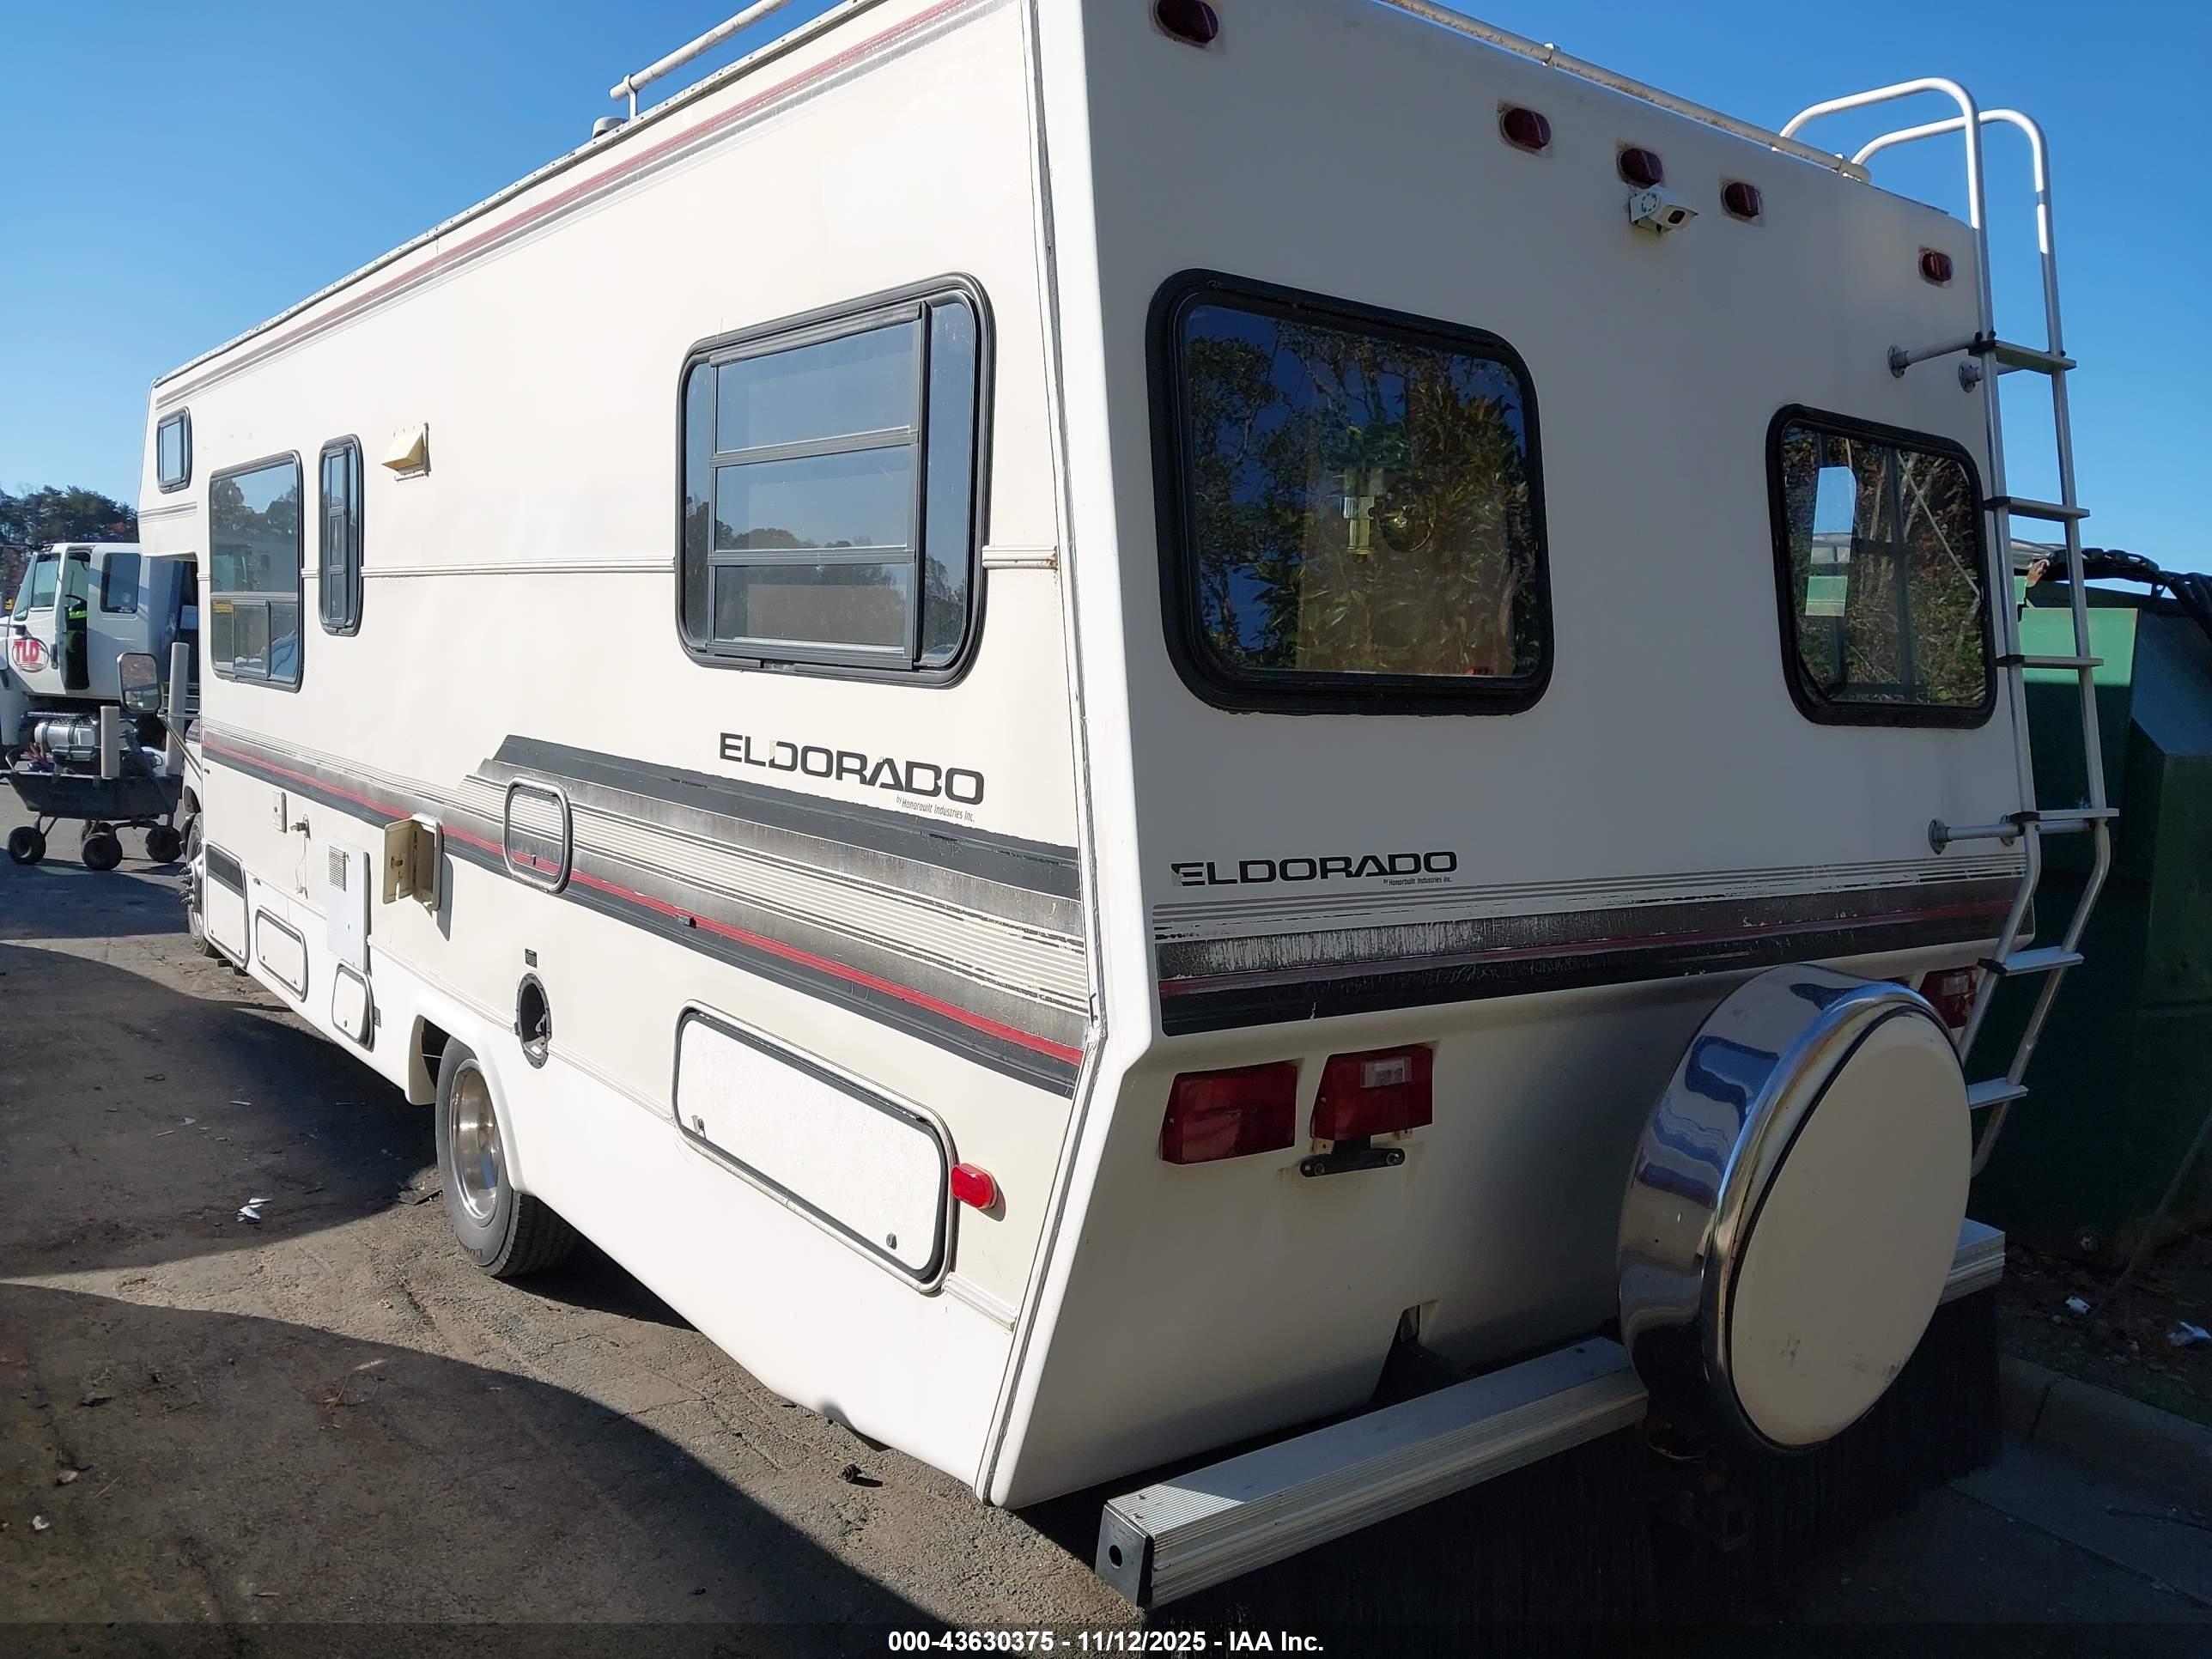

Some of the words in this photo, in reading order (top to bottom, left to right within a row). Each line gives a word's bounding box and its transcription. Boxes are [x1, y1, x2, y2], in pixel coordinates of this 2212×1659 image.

[14, 640, 40, 662] TLD
[720, 732, 985, 805] ELDORADO
[1170, 851, 1457, 886] ELDORADO
